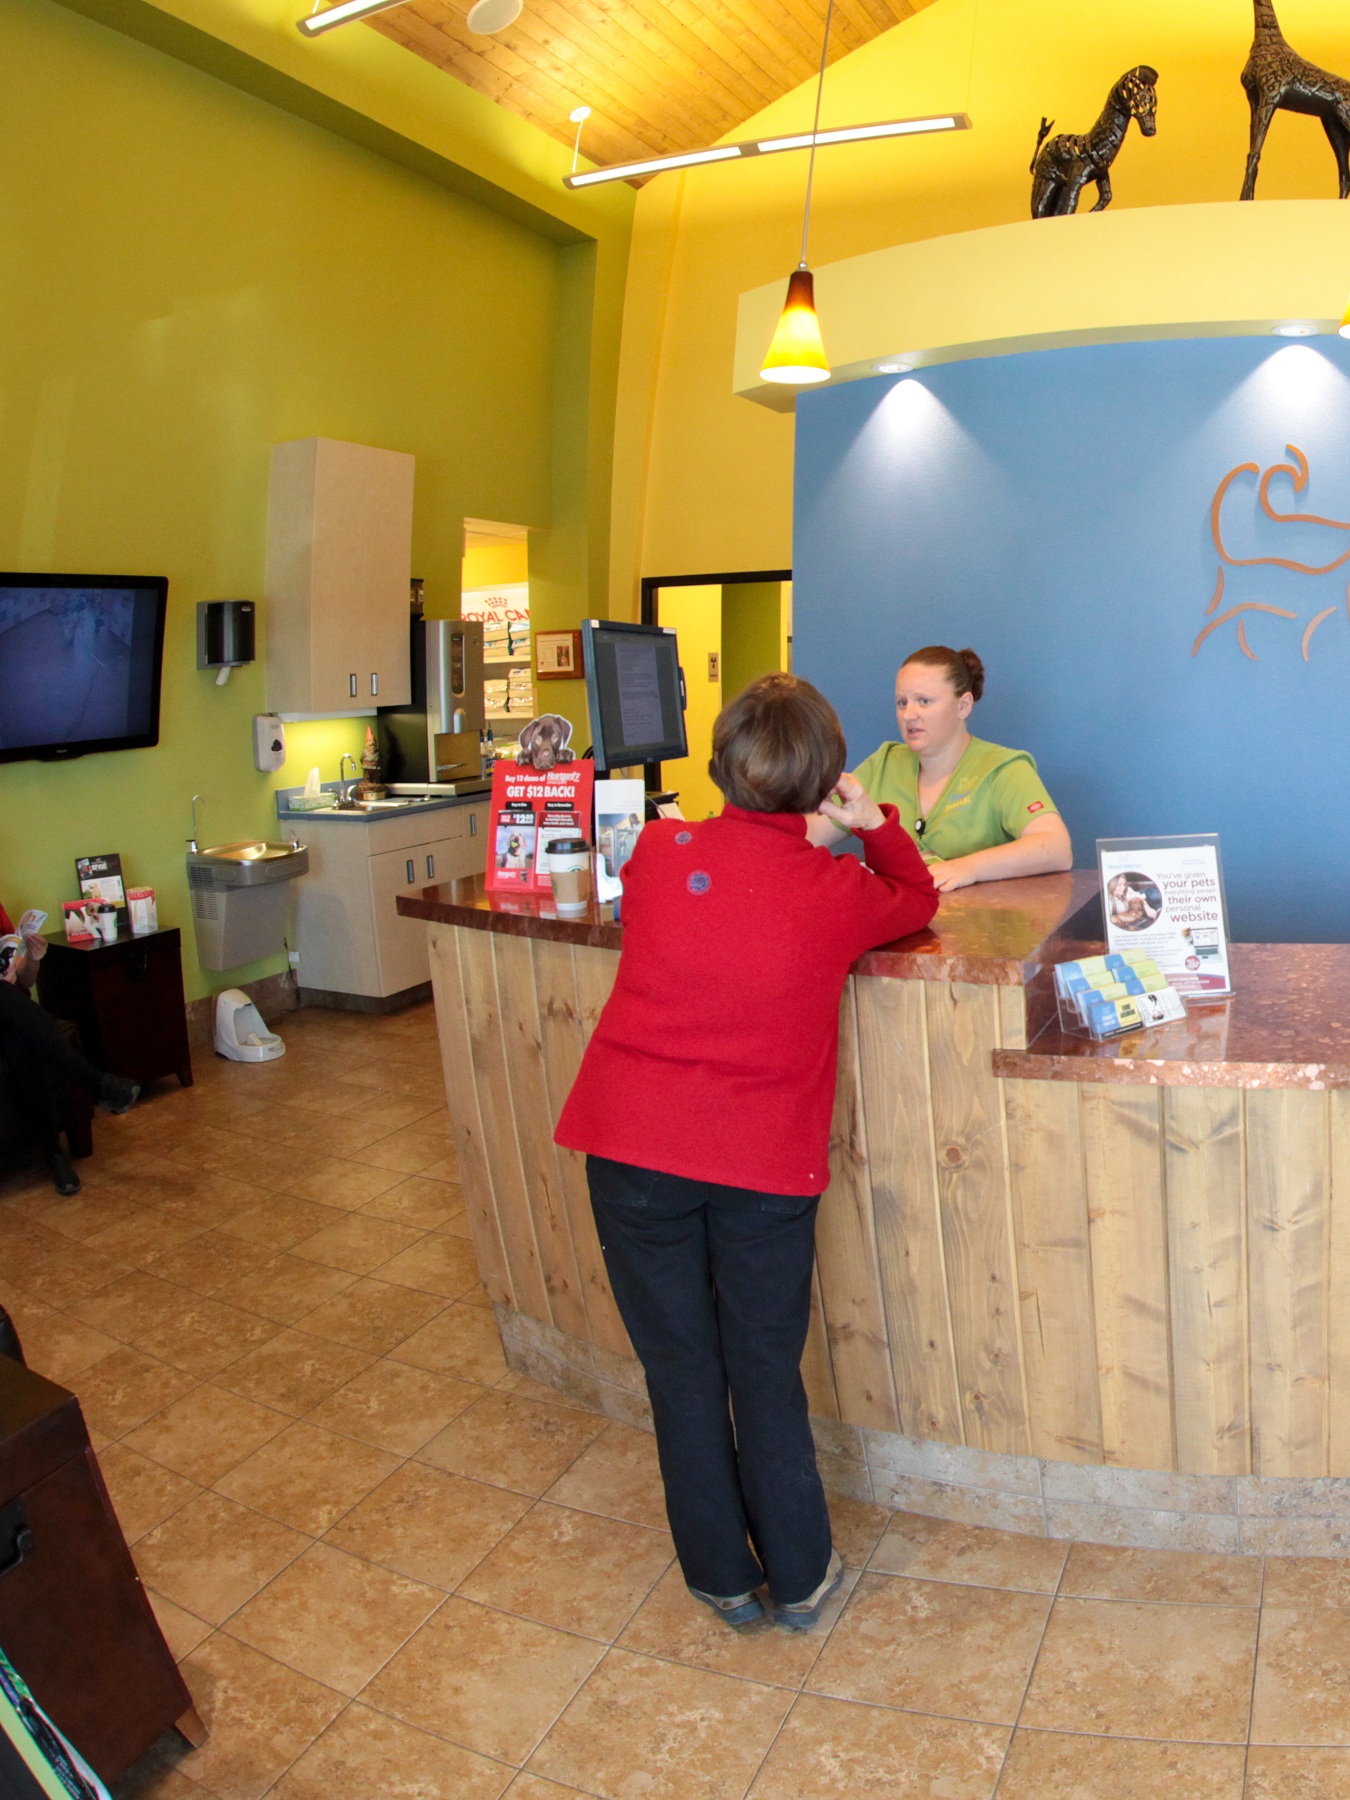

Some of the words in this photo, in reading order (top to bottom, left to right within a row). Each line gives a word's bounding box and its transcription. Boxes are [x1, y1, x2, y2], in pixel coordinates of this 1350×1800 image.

[507, 785, 525, 797] GET
[527, 785, 543, 798] $12
[544, 785, 575, 797] BACK!
[1156, 872, 1182, 880] You've
[1184, 871, 1206, 881] given
[1163, 880, 1188, 890] your
[1191, 878, 1216, 889] pets
[1196, 887, 1216, 895] except
[1168, 895, 1192, 905] their
[1195, 895, 1217, 903] own
[1166, 904, 1201, 913] personal
[1170, 910, 1218, 923] website
